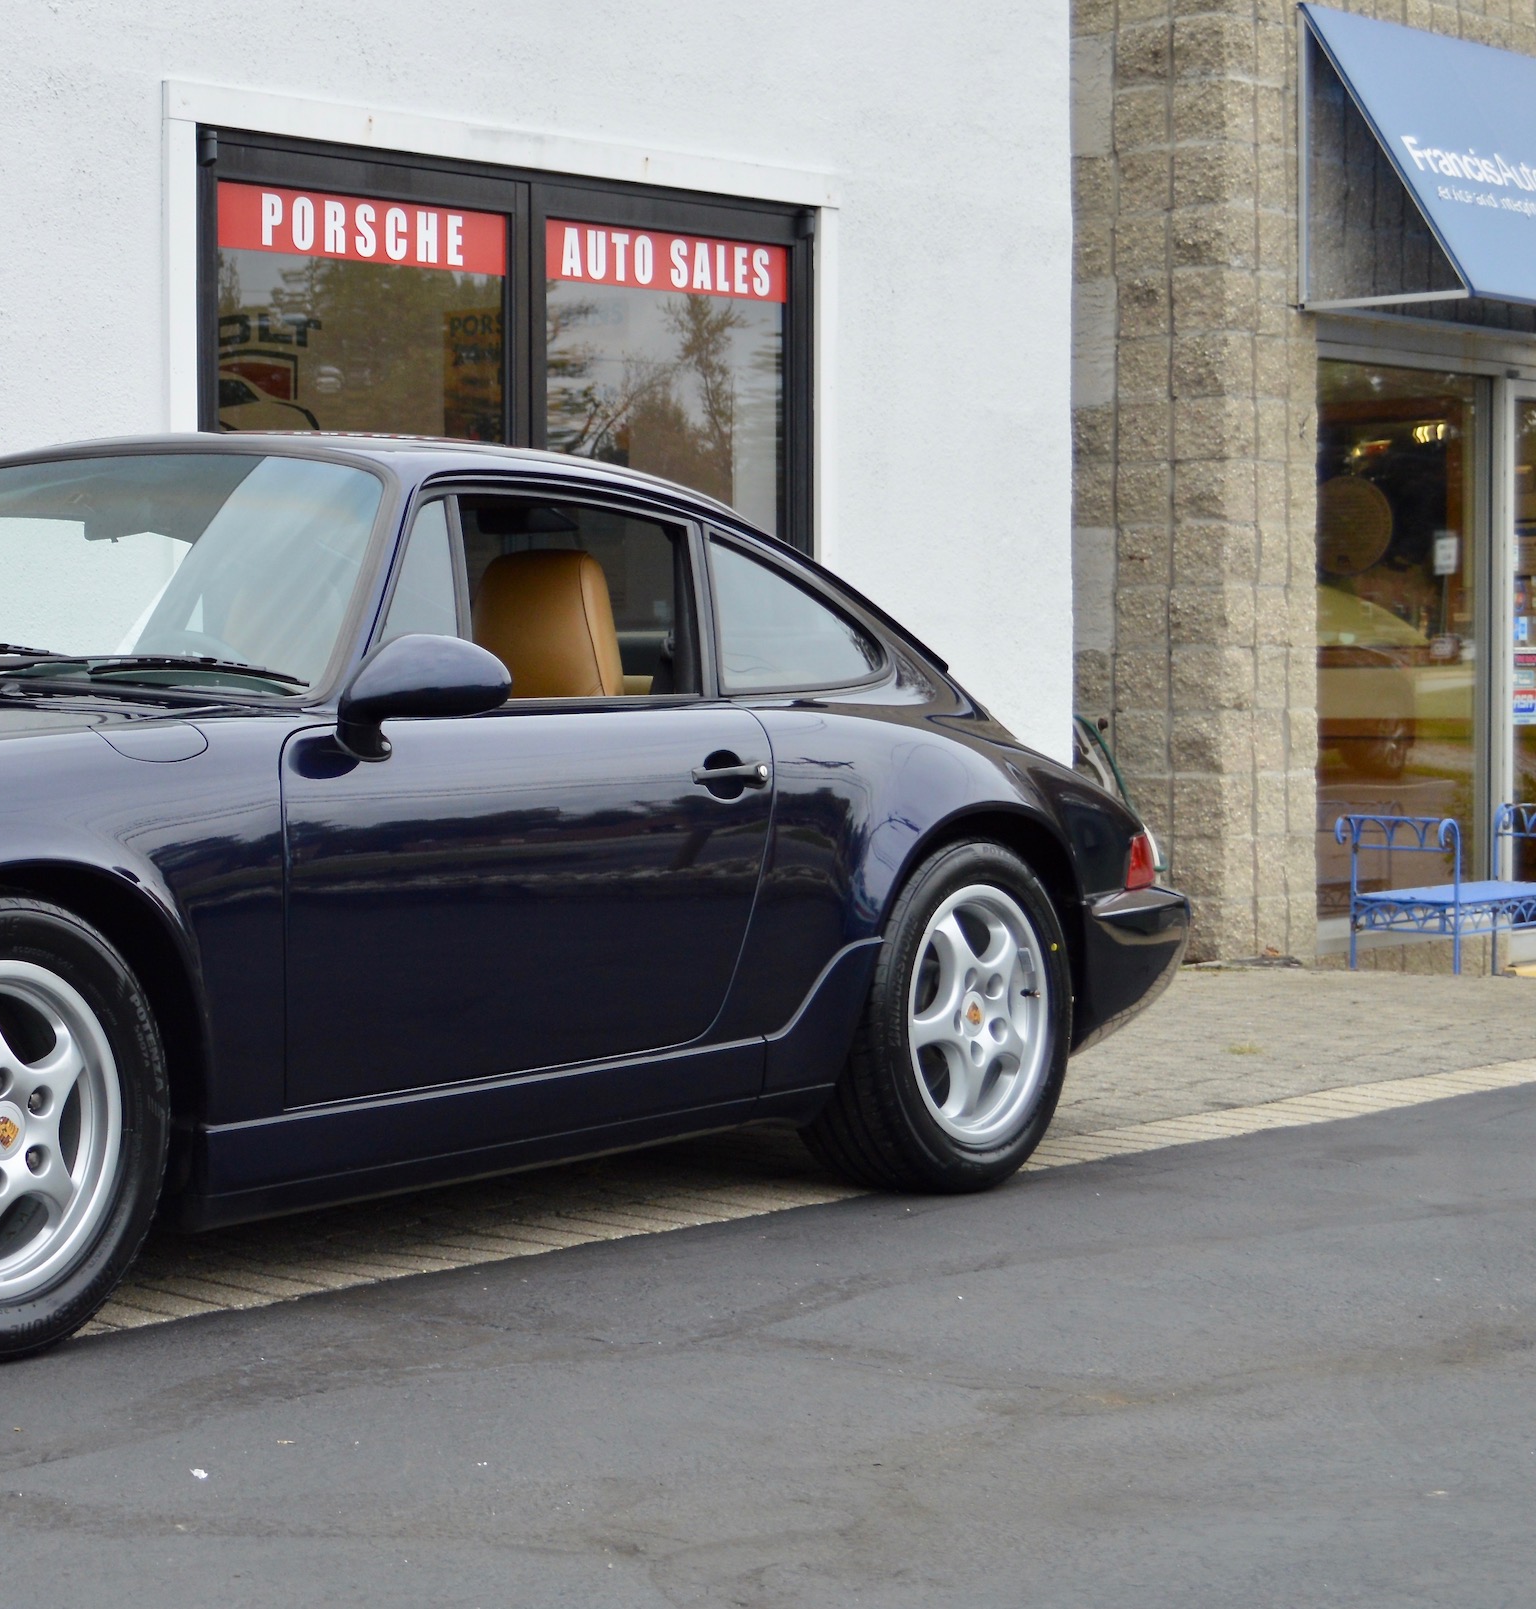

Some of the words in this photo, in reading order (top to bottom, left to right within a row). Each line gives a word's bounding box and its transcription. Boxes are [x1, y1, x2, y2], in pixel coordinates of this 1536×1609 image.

[261, 192, 464, 268] PORSCHE
[561, 226, 654, 285] AUTO
[669, 238, 771, 297] SALES
[129, 992, 166, 1093] POTENZA
